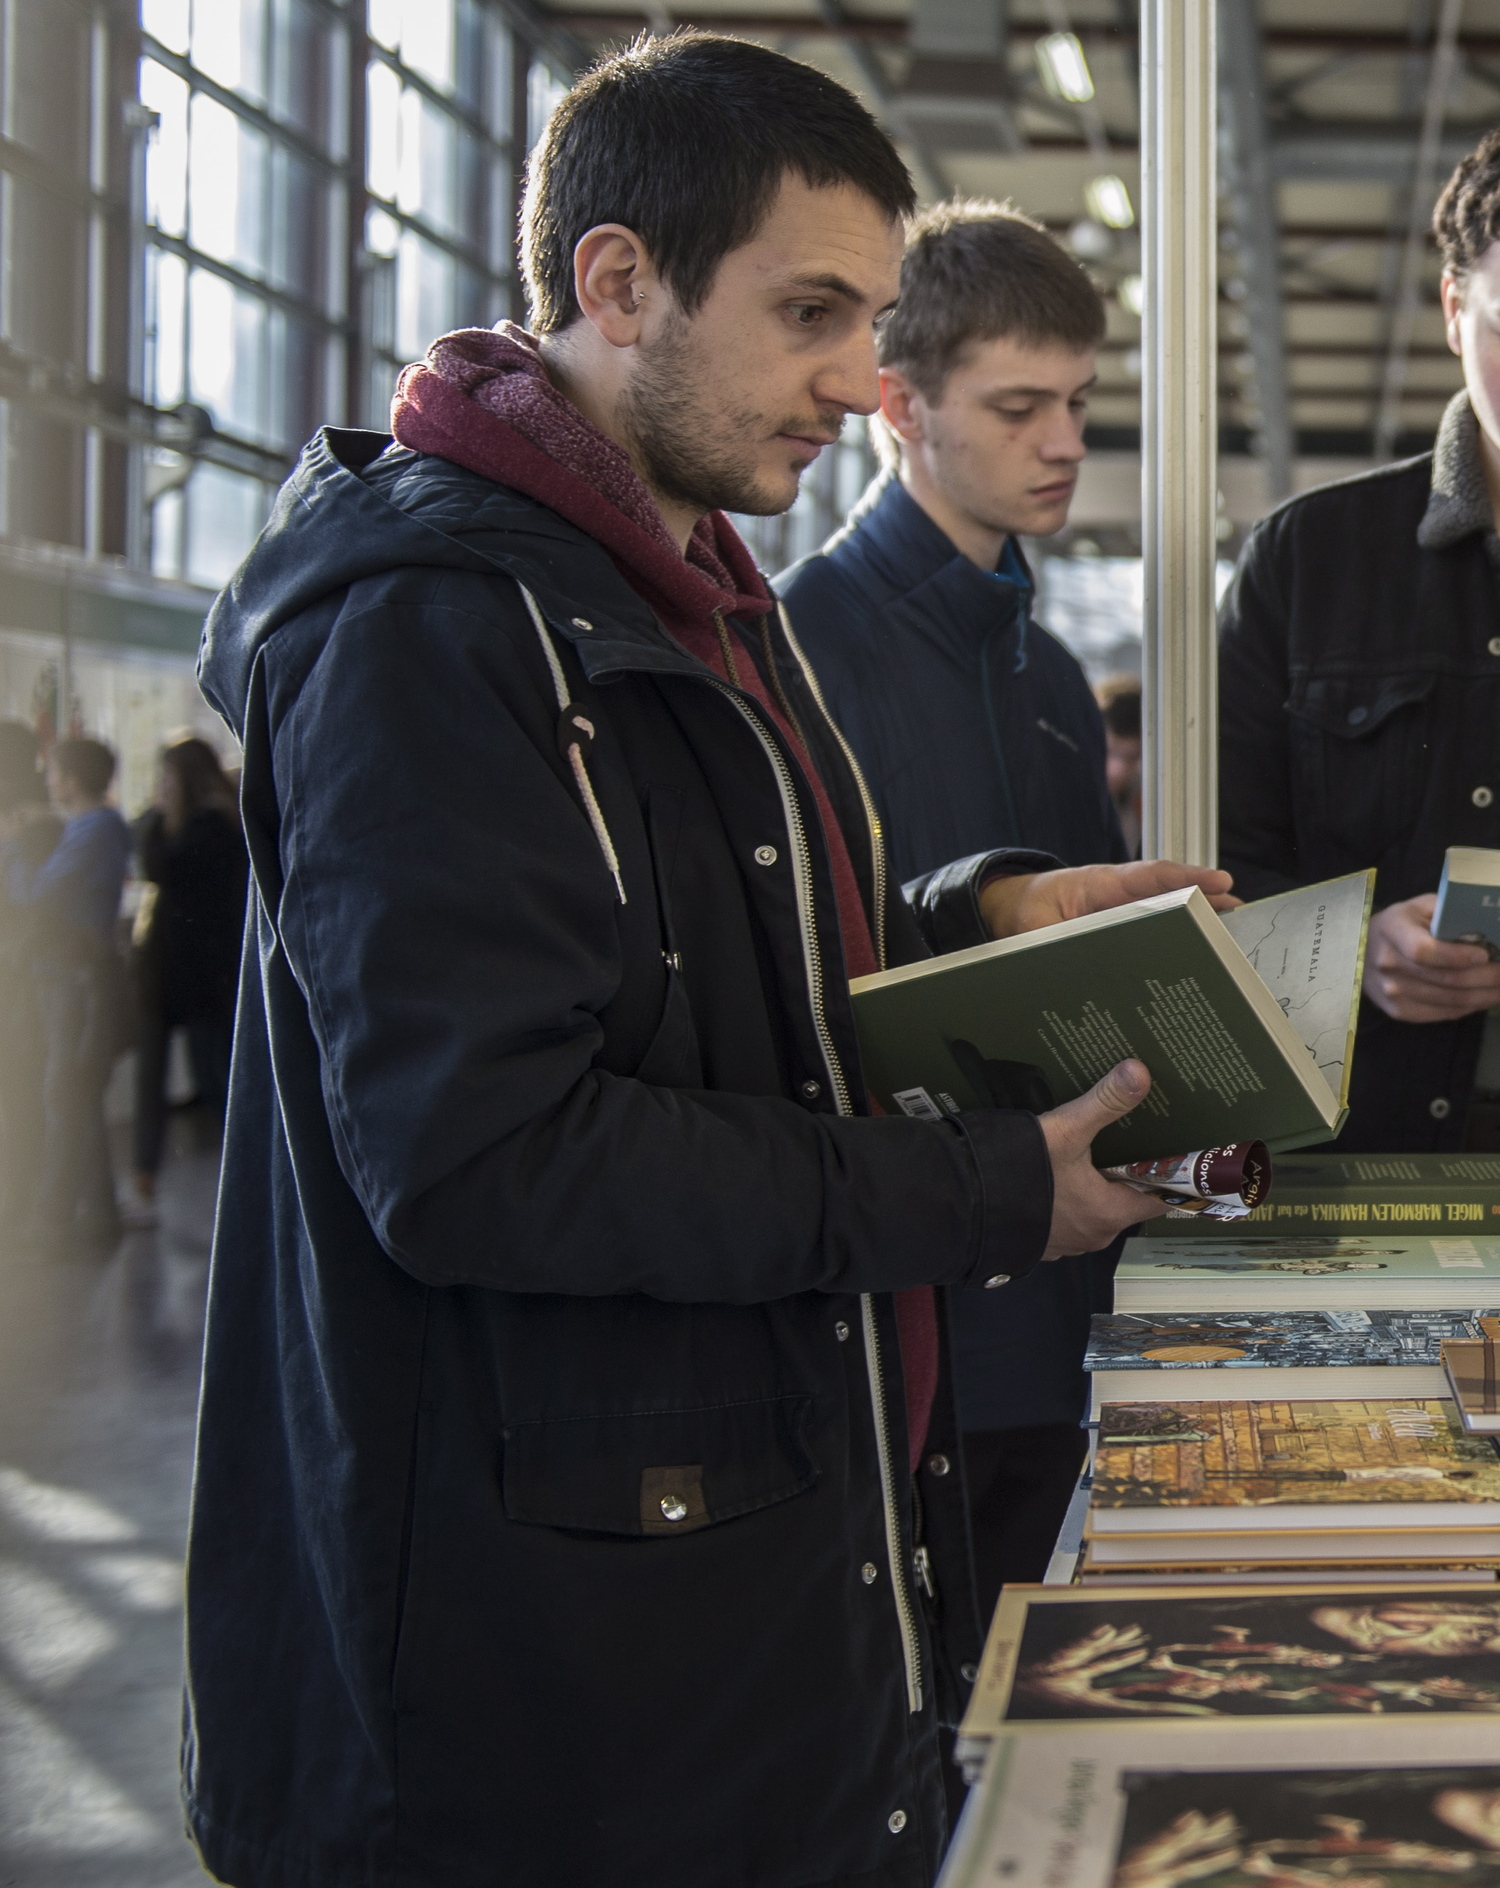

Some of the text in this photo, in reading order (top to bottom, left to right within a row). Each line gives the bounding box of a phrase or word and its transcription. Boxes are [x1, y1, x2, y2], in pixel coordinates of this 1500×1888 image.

[1308, 905, 1326, 983] GUATEMALA
[1310, 1203, 1369, 1221] HAMAIKA
[1371, 1203, 1442, 1221] MARMOLEN
[1447, 1203, 1484, 1221] MIGEL
